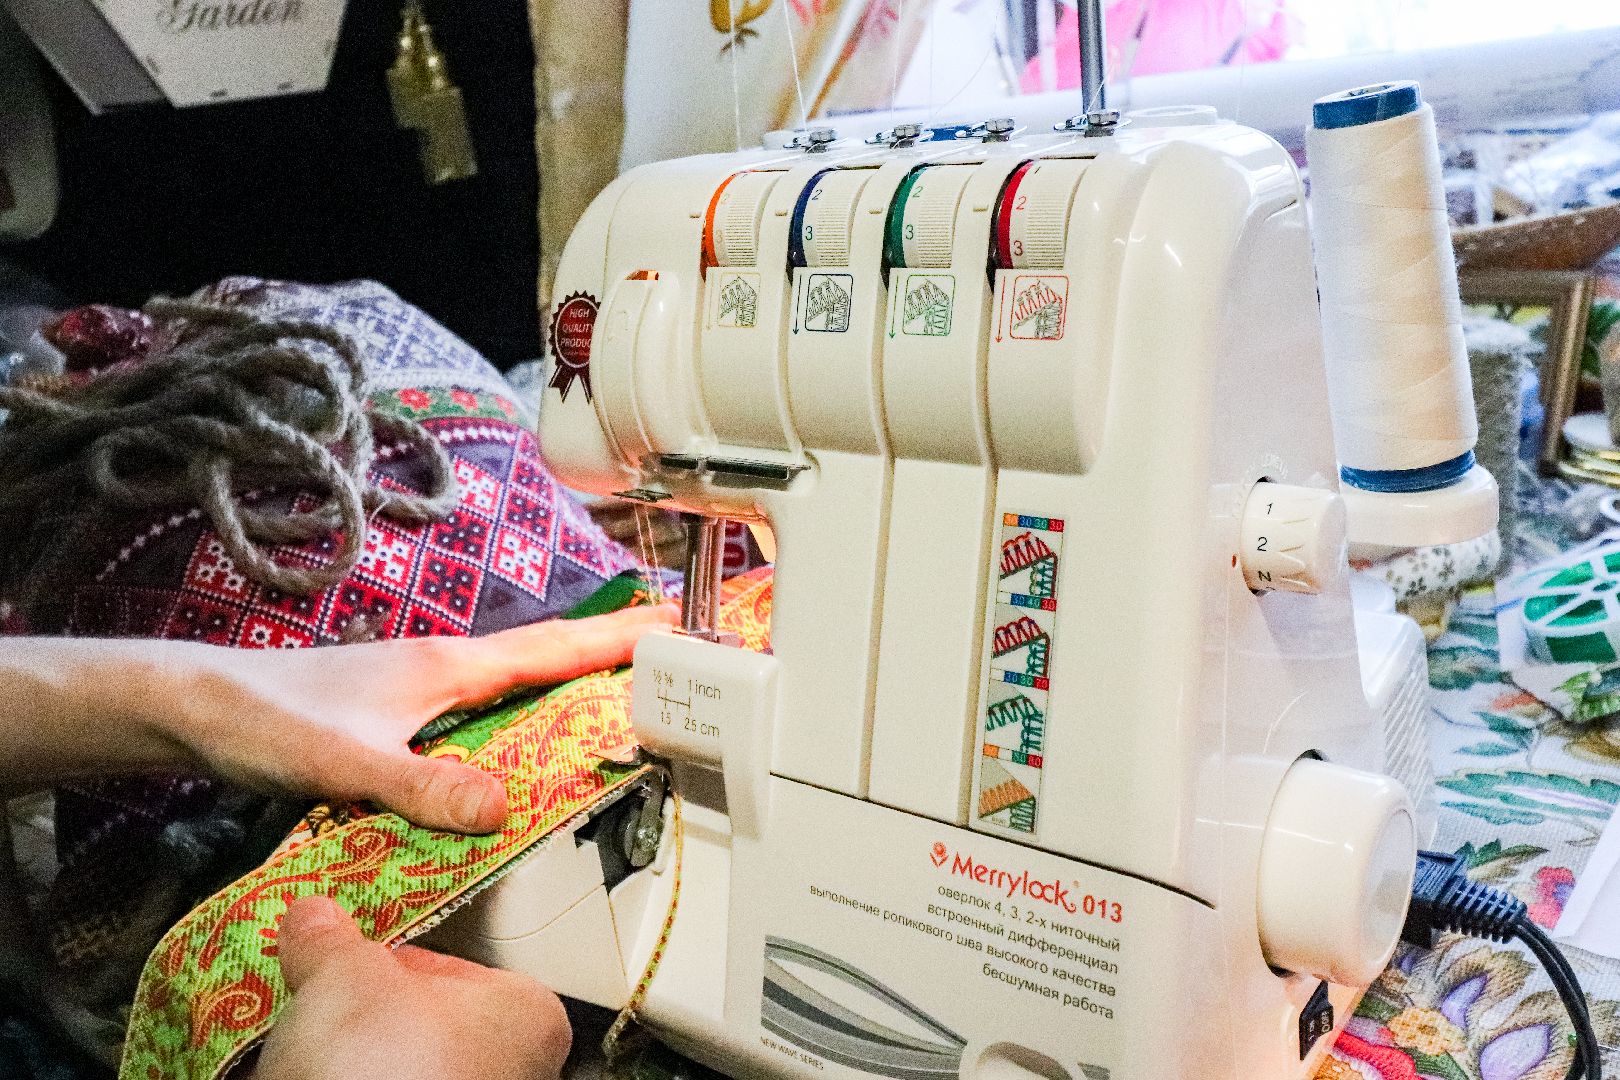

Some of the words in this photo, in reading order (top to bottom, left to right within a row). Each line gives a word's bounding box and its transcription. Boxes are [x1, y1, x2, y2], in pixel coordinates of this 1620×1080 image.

[811, 188, 823, 201] 2
[912, 186, 924, 198] 2
[1016, 195, 1027, 210] 2
[805, 225, 813, 241] 3
[905, 224, 914, 241] 3
[1013, 240, 1024, 256] 3
[569, 308, 590, 318] HIGH
[560, 339, 592, 348] PRODUC
[1266, 502, 1273, 515] 1
[1256, 536, 1268, 552] 2
[695, 679, 721, 700] inch
[700, 723, 720, 738] cm
[1082, 895, 1123, 924] 013
[937, 884, 991, 911] оверлок
[1050, 921, 1121, 953] ниточный
[809, 884, 881, 917] выполнение
[882, 909, 954, 942] роликового
[956, 934, 984, 953] шва
[986, 944, 1050, 975] высокого
[1051, 966, 1117, 998] качества
[927, 903, 1005, 937] встроенный
[1007, 929, 1119, 975] дифференциал
[982, 962, 1061, 1001] бесшумная
[1062, 993, 1115, 1021] работа
